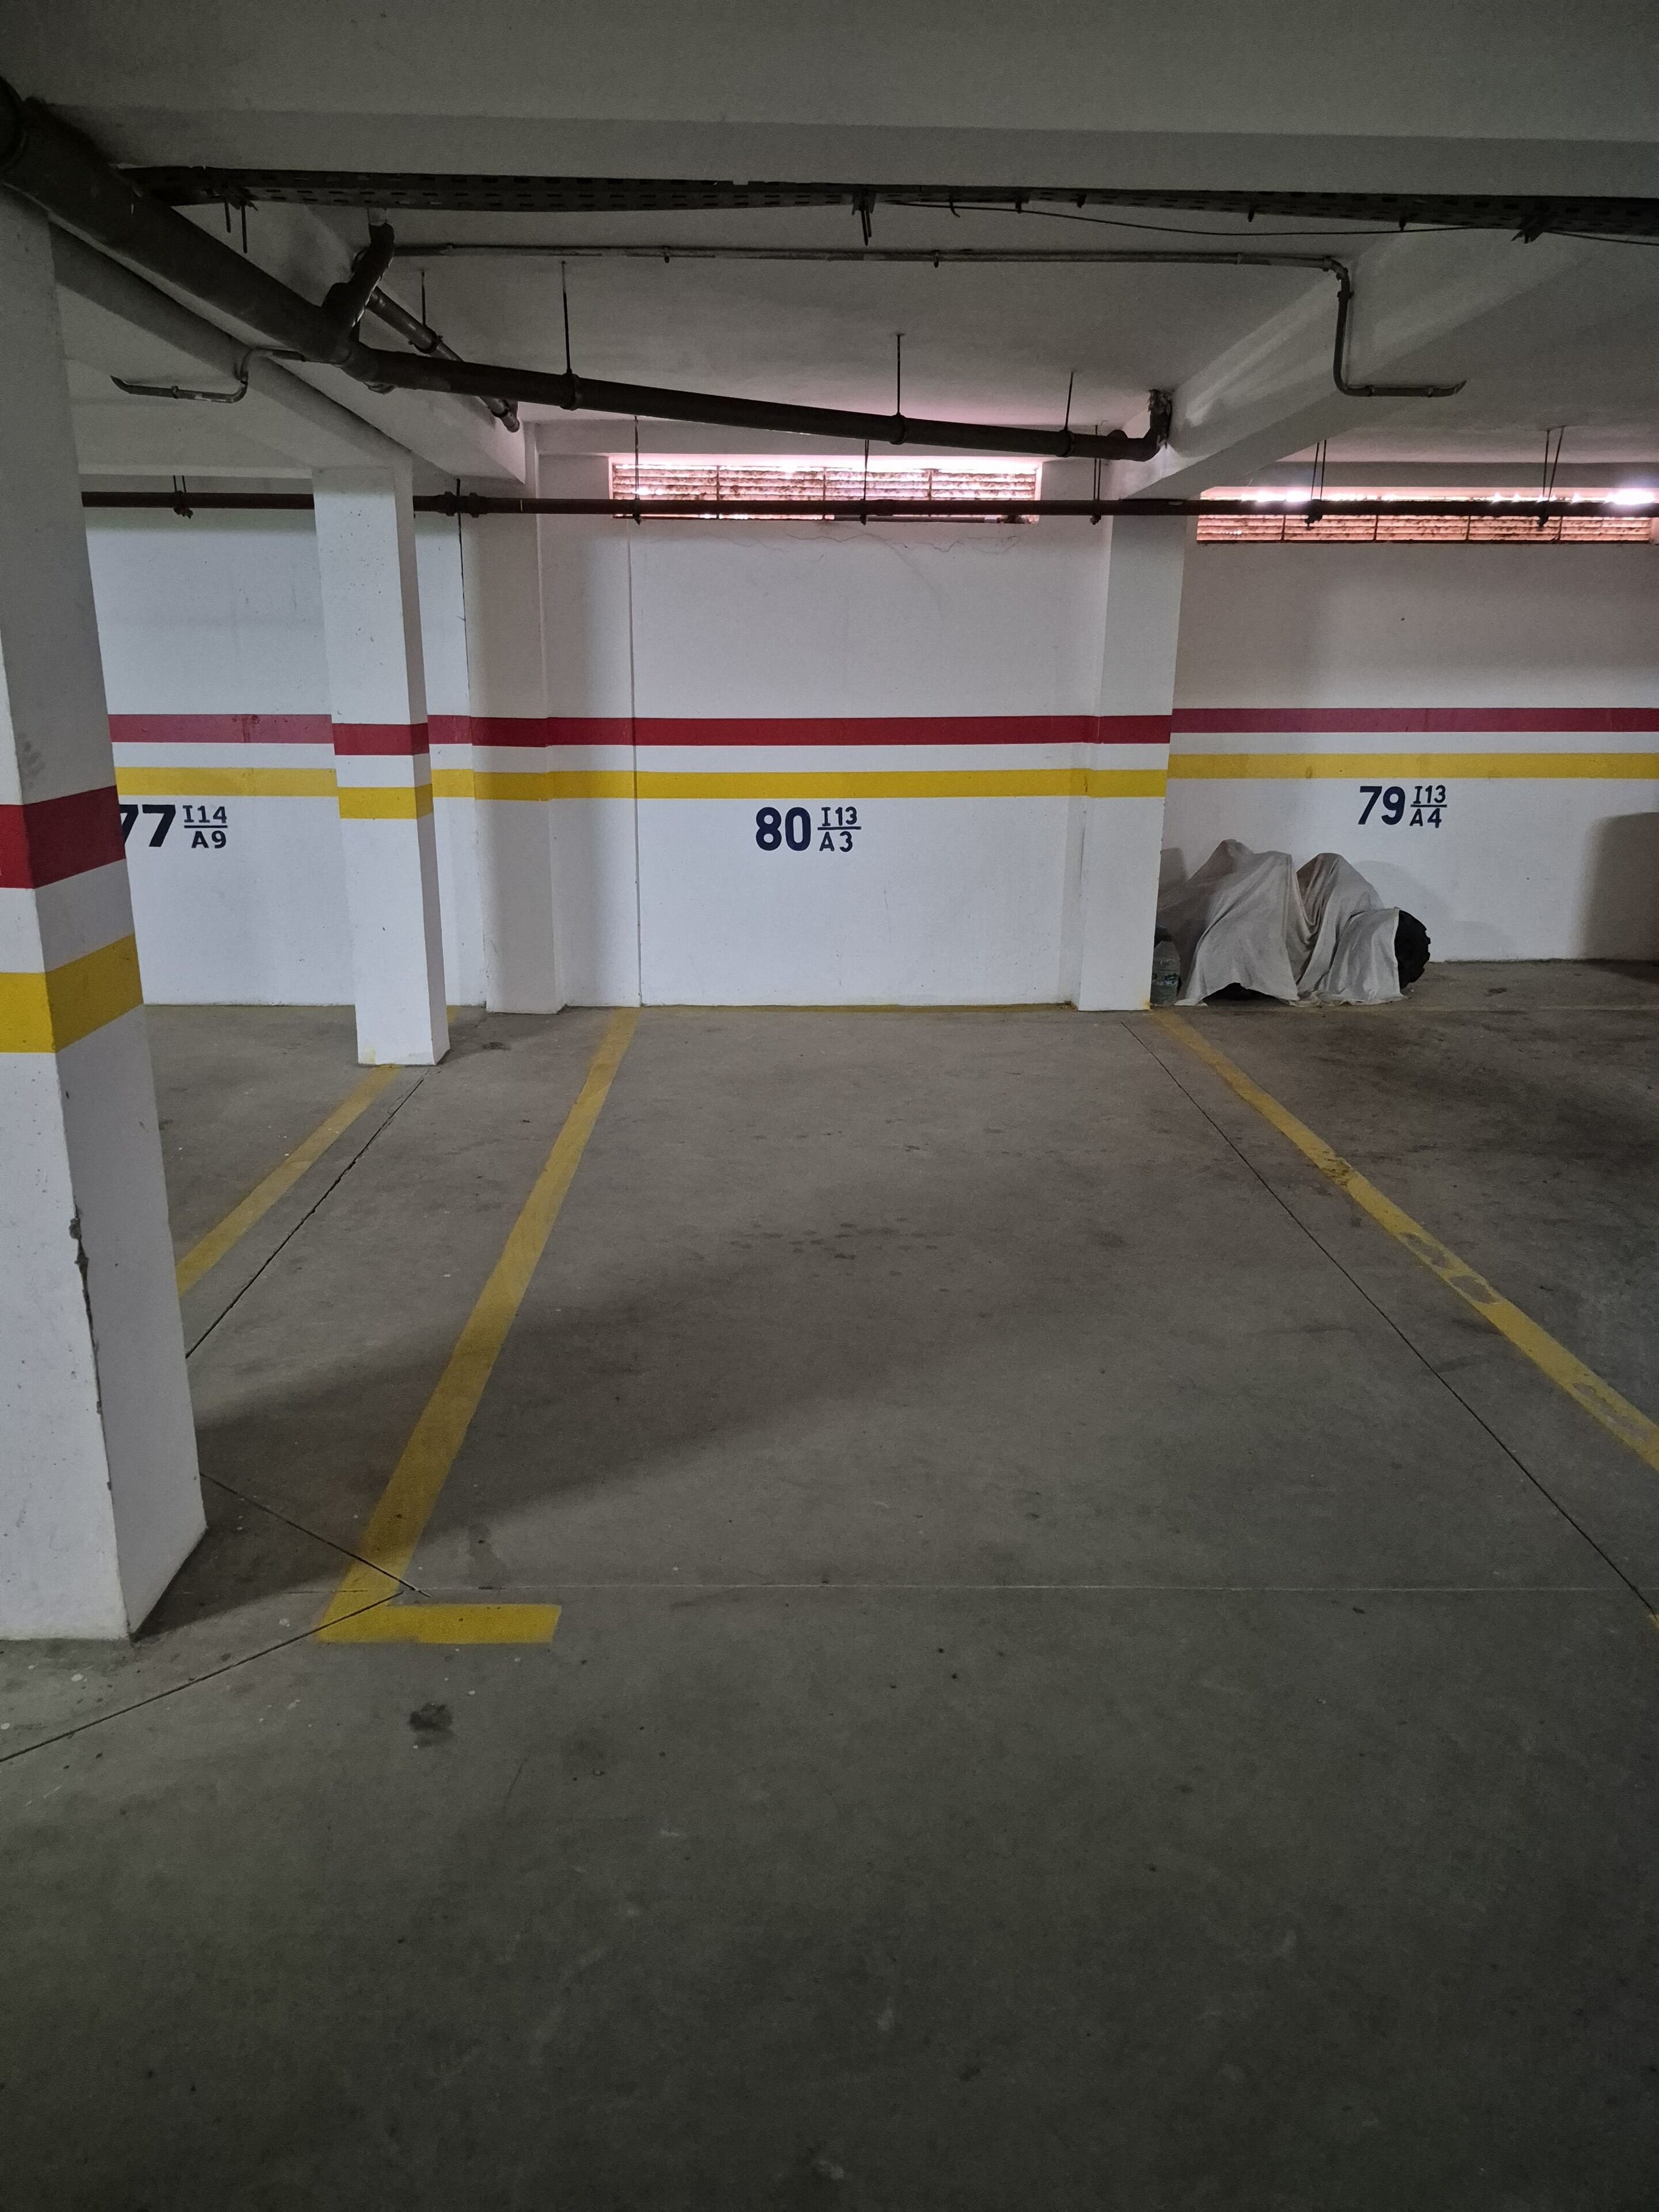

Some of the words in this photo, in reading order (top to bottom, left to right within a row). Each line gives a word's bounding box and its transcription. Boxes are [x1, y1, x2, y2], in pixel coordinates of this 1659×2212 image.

[1413, 785, 1446, 804] I13
[182, 805, 227, 824] I14
[1358, 786, 1406, 825] 79
[756, 806, 811, 851] 80
[1409, 808, 1442, 829] A4
[191, 831, 227, 849] A9
